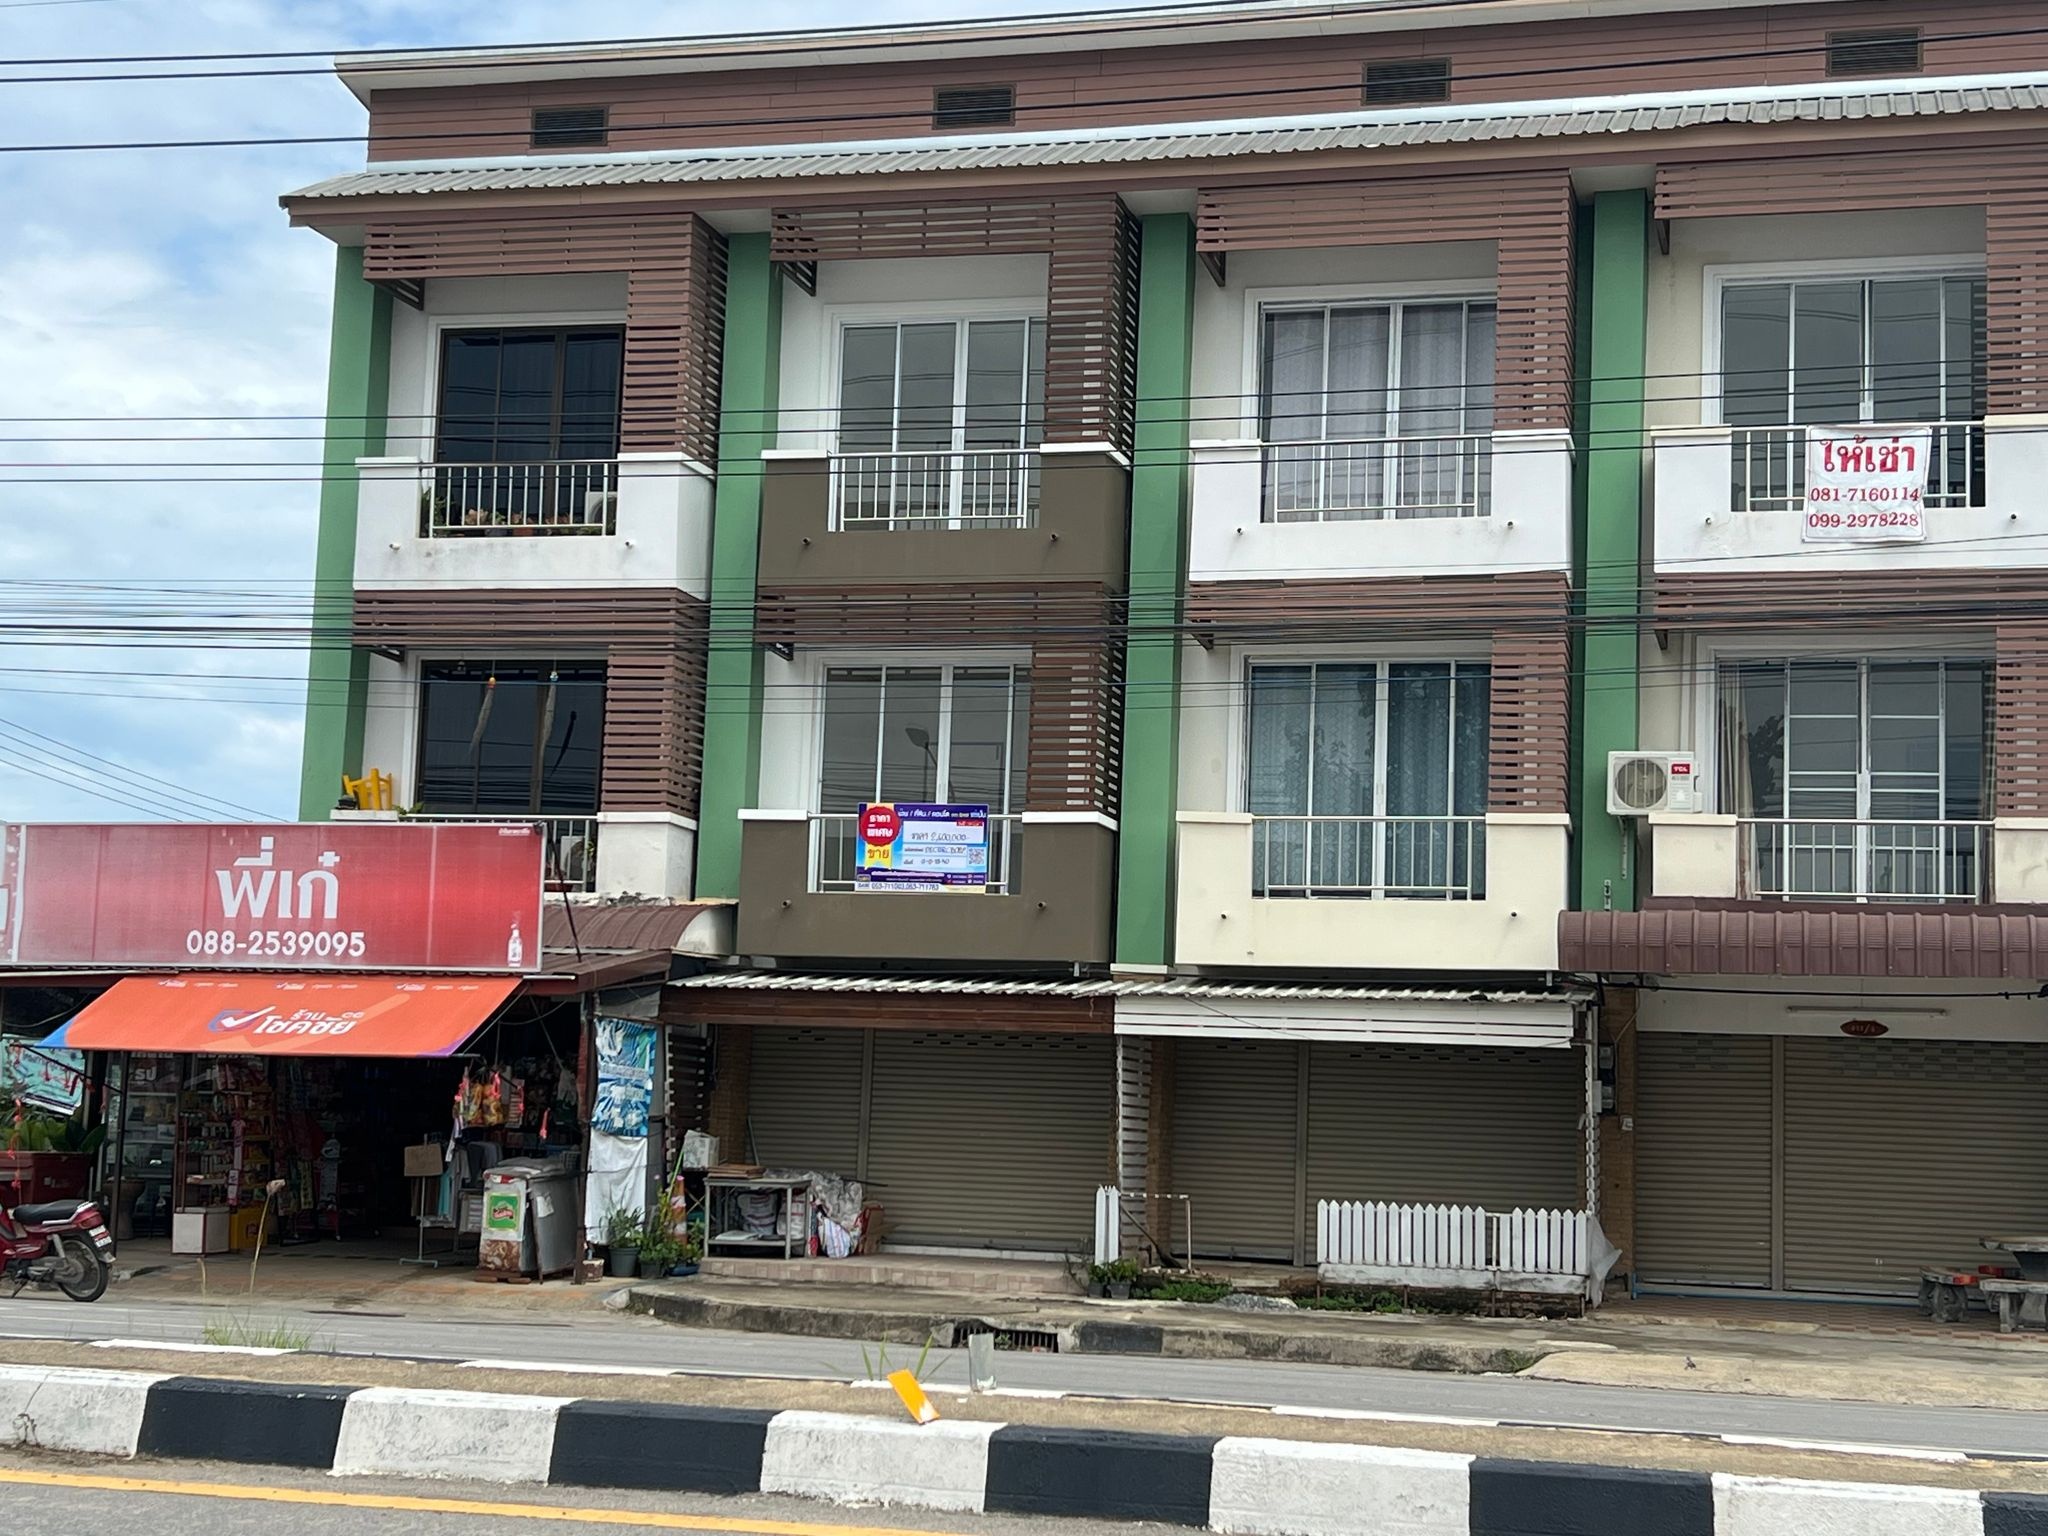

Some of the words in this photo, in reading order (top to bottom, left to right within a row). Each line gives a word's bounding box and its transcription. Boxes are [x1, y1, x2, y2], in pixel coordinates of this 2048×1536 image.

[1819, 434, 1917, 473] ให้เช่า
[1810, 487, 1921, 502] 081-7160114
[1809, 512, 1919, 528] 099-2978228
[869, 814, 891, 822] ราคา
[866, 824, 894, 837] พิเศษ
[867, 848, 890, 859] ขาย
[215, 836, 341, 919] พี่เก๋
[186, 930, 366, 957] 088-2539095
[290, 1009, 326, 1021] ร้าน
